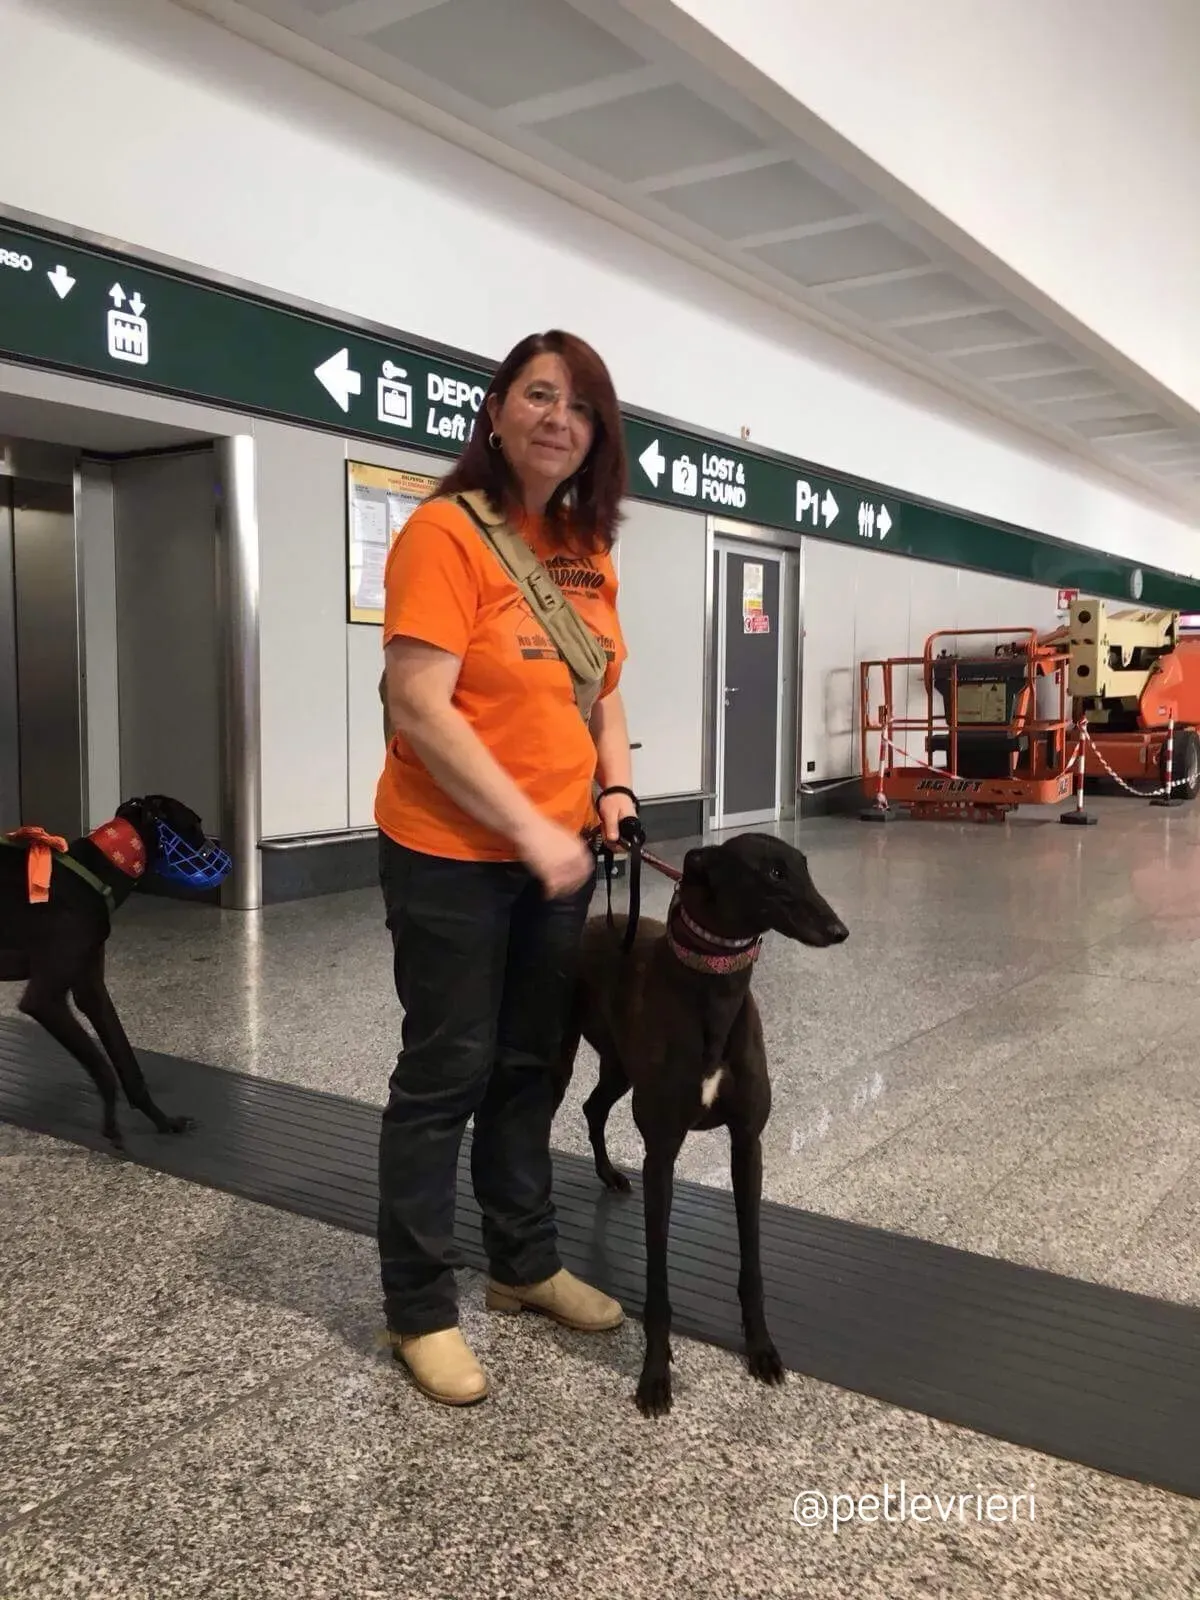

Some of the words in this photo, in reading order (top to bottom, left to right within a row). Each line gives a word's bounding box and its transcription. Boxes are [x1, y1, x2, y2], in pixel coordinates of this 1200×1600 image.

[426, 407, 467, 442] Left
[702, 453, 735, 482] LOST
[736, 463, 746, 484] &
[702, 478, 746, 508] FOUND
[795, 480, 819, 526] P1
[948, 780, 983, 793] LIFT
